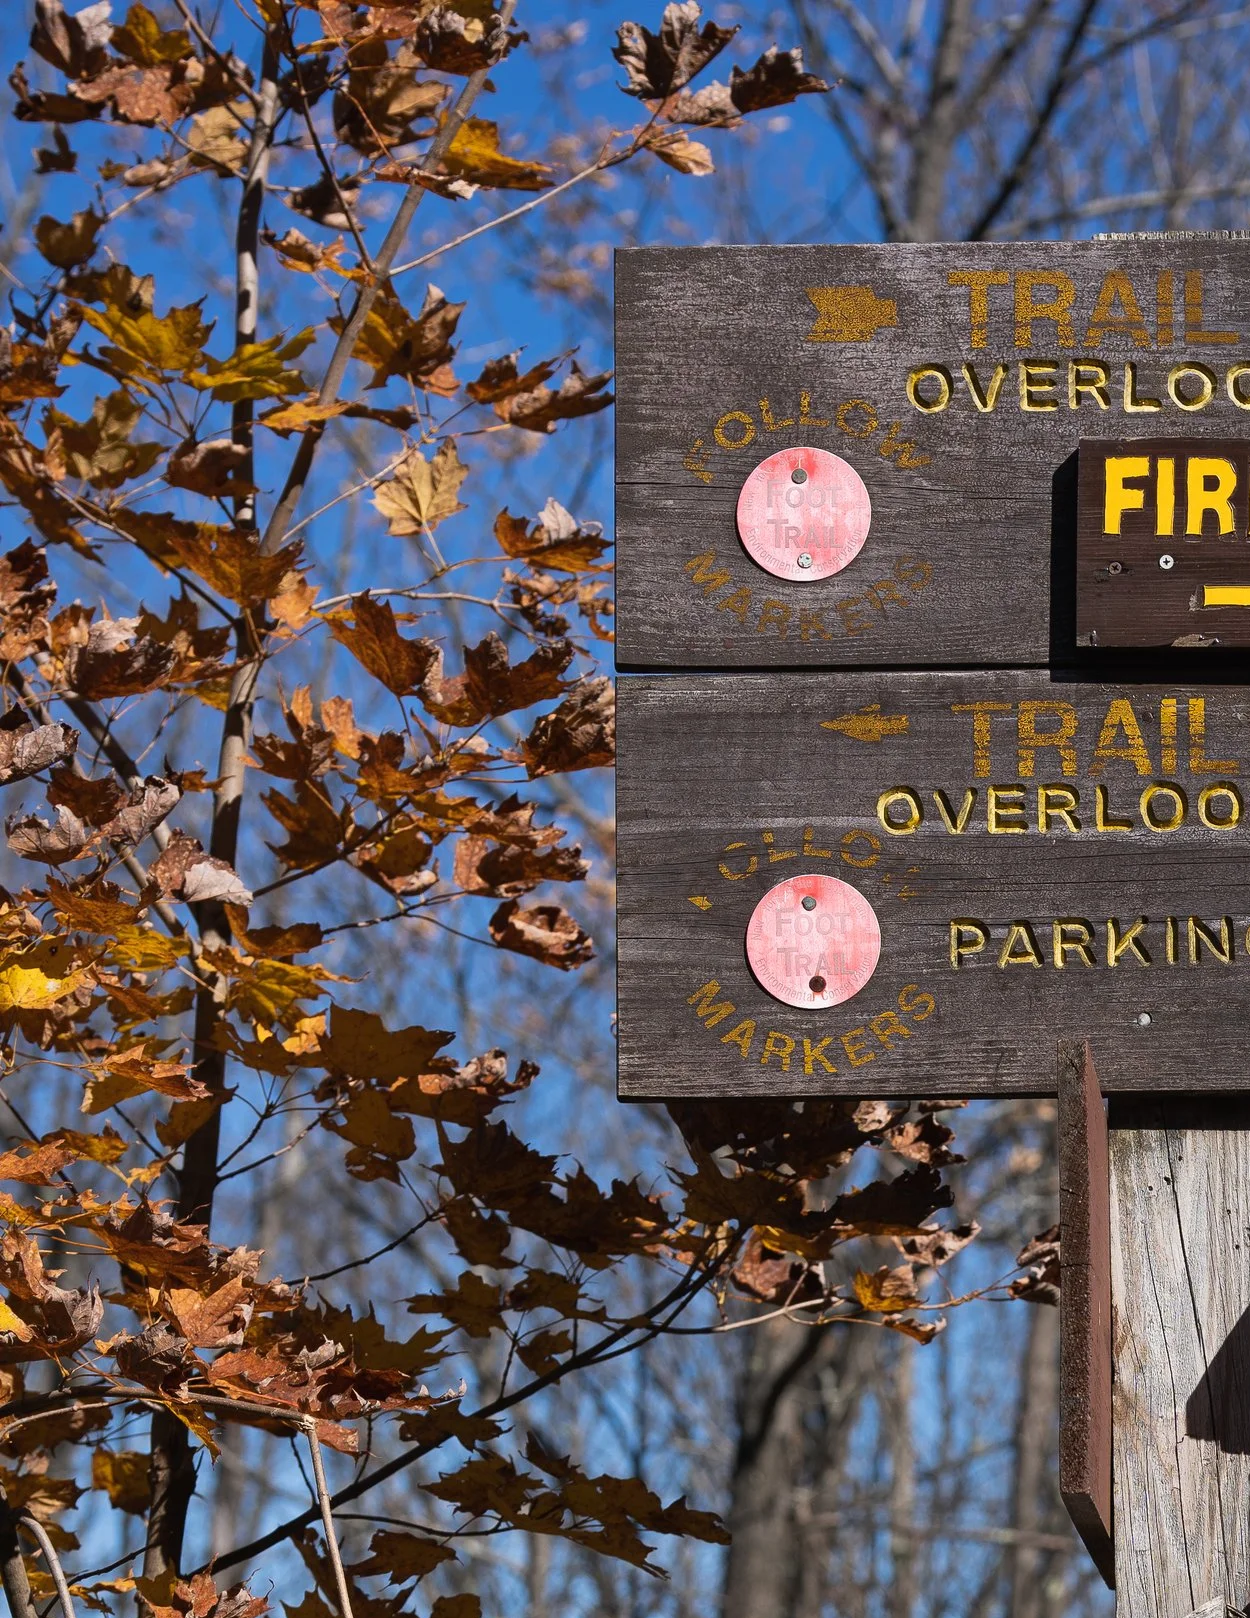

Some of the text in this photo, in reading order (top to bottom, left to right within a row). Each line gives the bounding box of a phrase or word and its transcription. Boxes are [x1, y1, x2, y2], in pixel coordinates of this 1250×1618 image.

[948, 268, 1240, 349] TRAIL
[683, 391, 933, 484] FOLLOW
[684, 549, 933, 642] MARKERS
[951, 697, 1240, 777] TRAIL
[687, 980, 937, 1076] MARKERS
